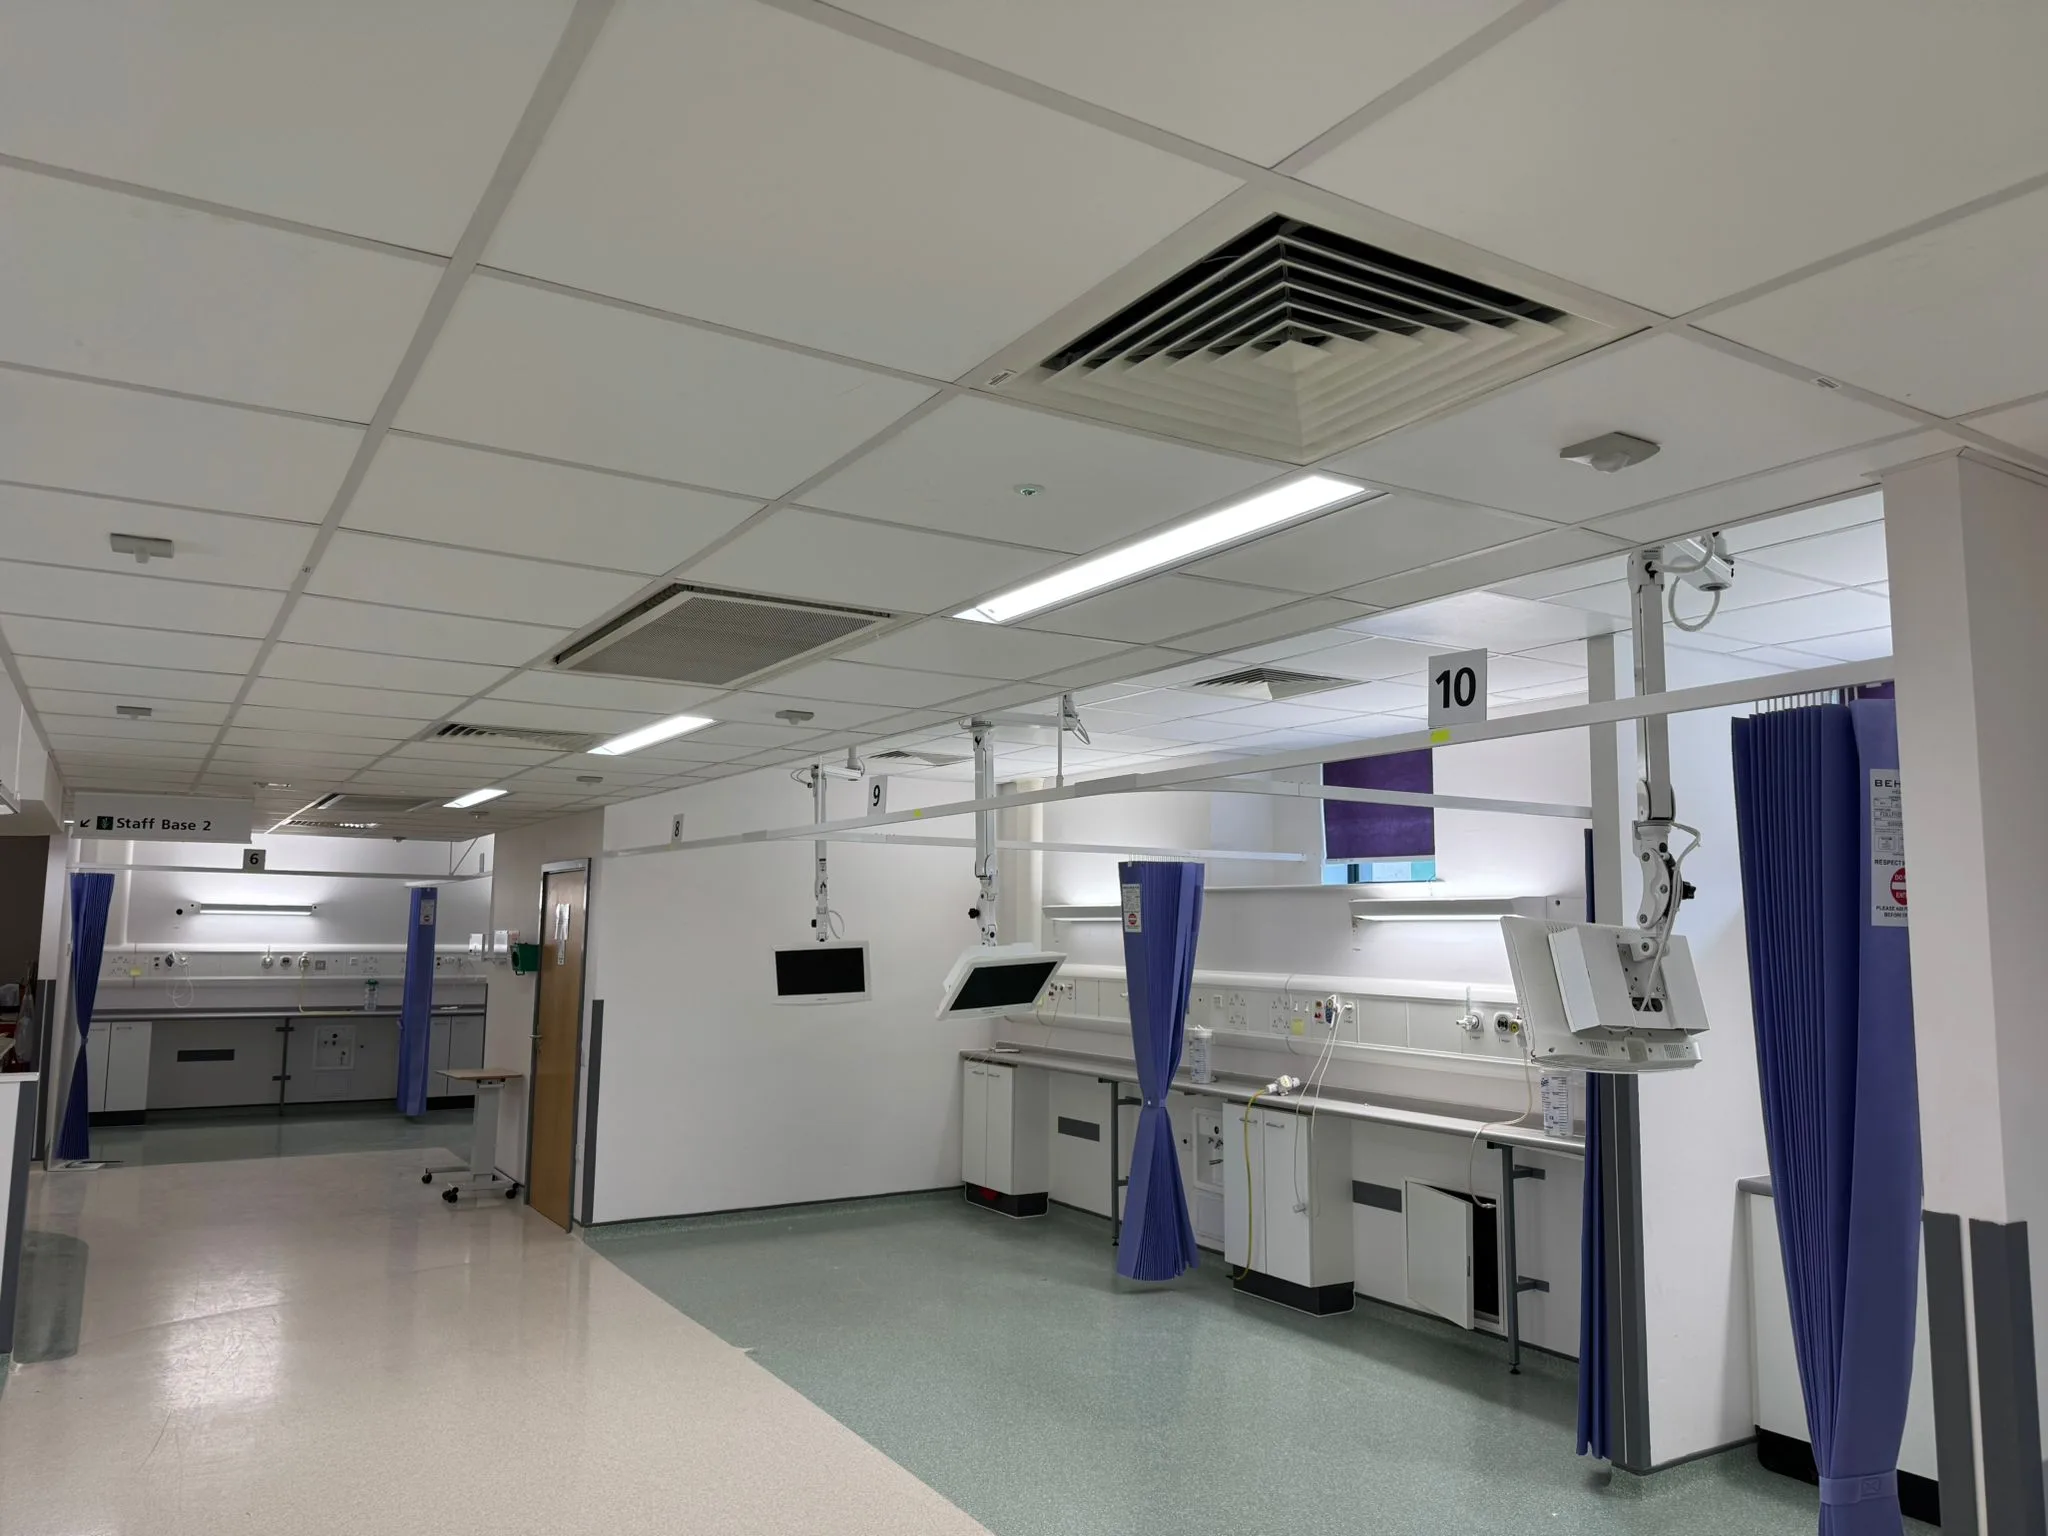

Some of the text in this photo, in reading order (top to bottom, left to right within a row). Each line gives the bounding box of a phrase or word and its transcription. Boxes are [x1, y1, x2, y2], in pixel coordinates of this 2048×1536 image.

[1435, 666, 1476, 708] 10
[873, 784, 881, 806] 9
[116, 817, 212, 831] Staff Base 2
[674, 820, 680, 837] 8
[249, 853, 259, 865] 6
